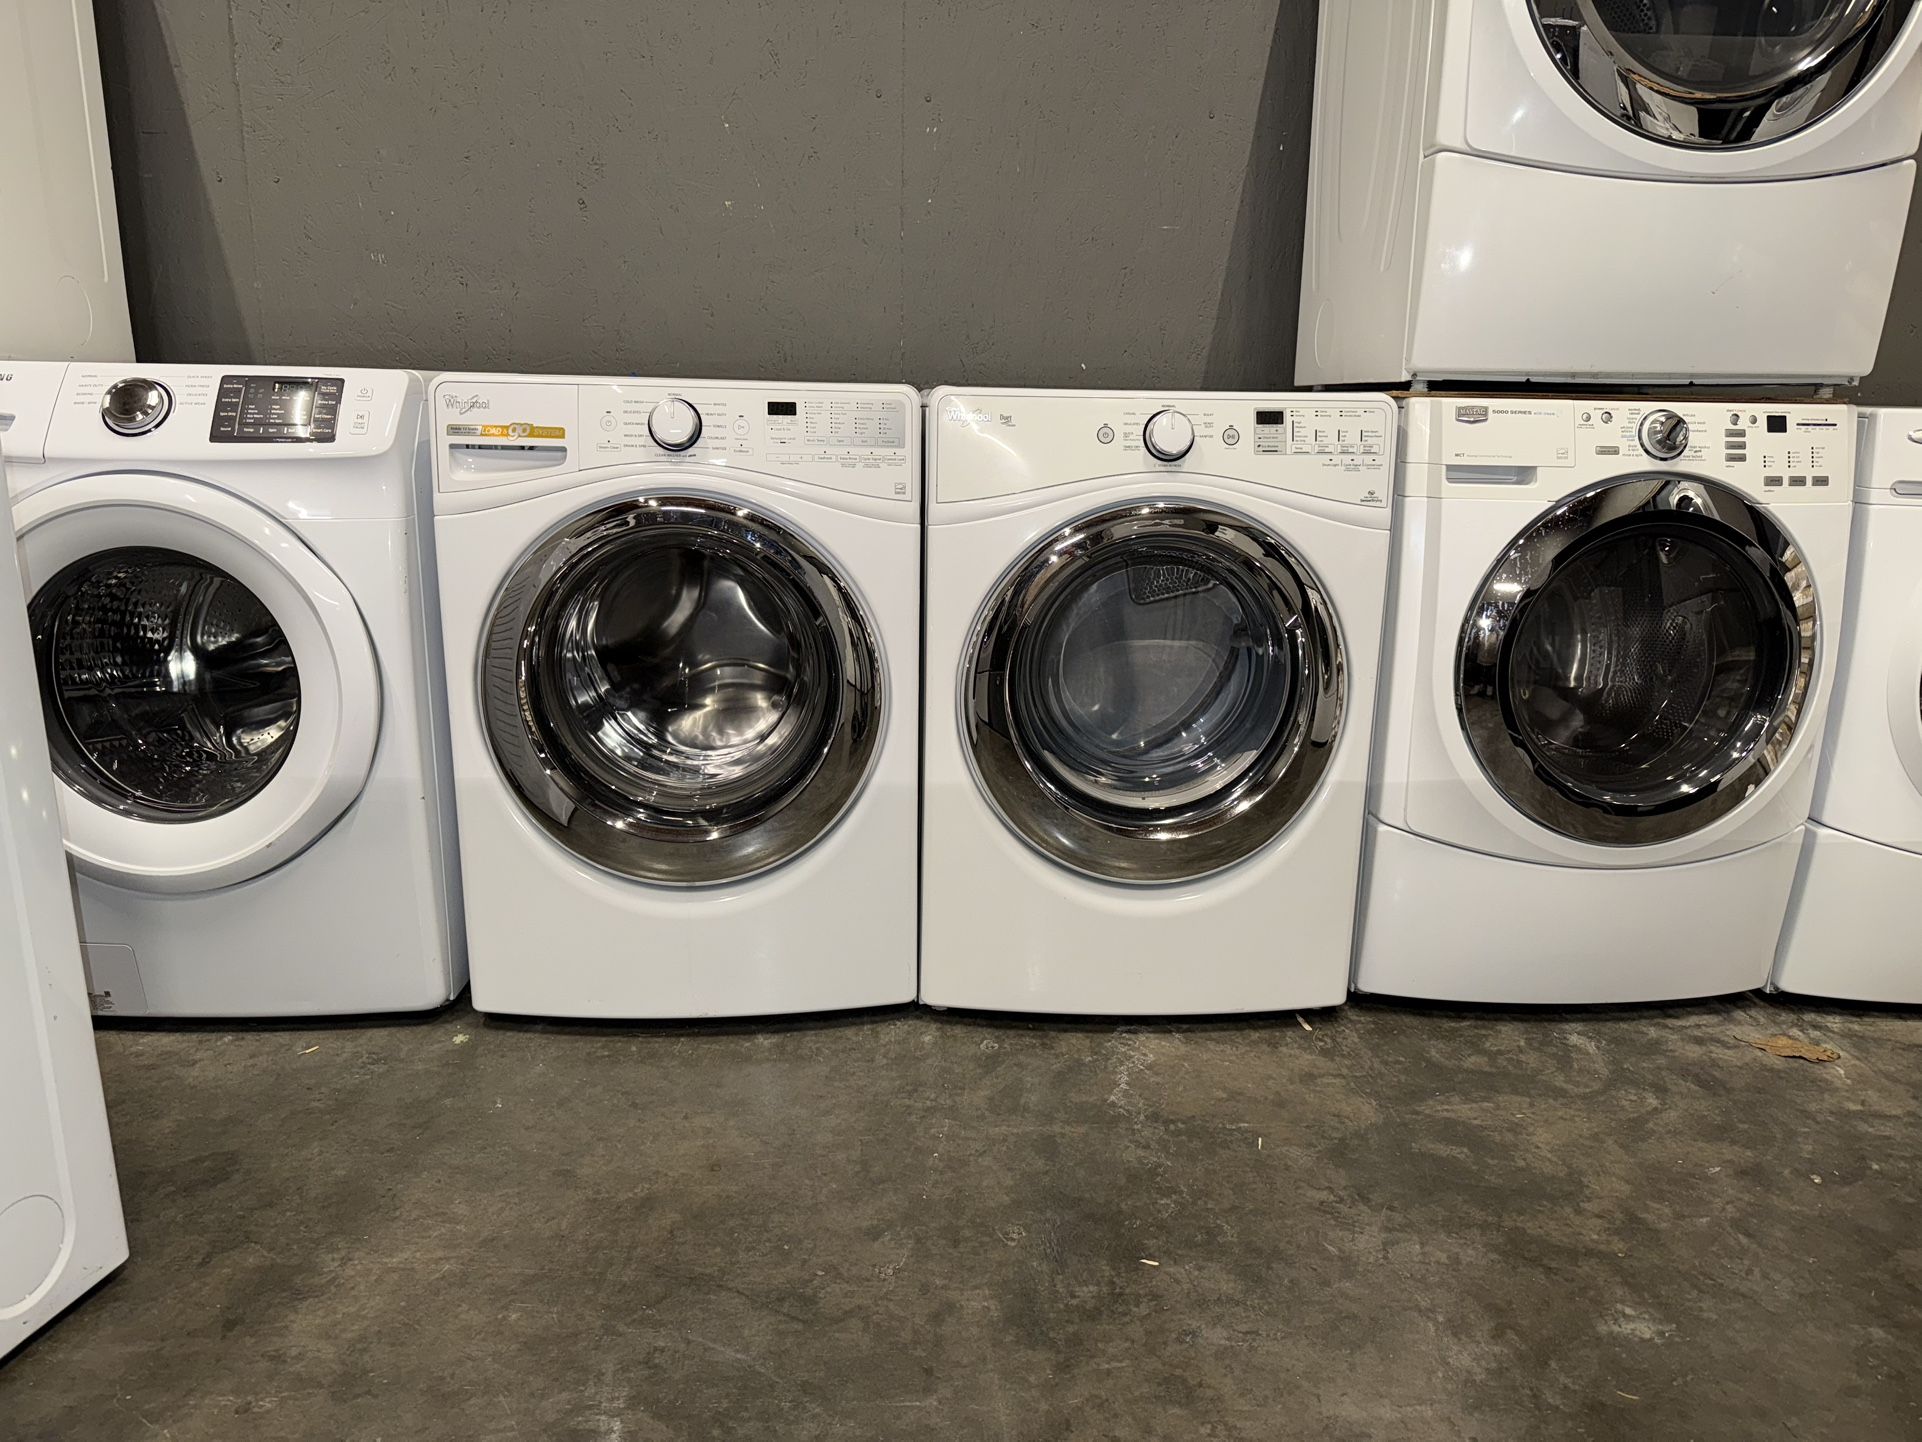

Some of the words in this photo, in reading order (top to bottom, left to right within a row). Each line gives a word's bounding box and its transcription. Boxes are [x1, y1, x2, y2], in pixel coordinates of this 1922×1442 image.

[444, 396, 490, 412] Whirlpool
[1460, 407, 1486, 415] MAYTAG
[999, 413, 1012, 422] Duet
[481, 427, 502, 436] LOAD
[508, 422, 531, 441] go
